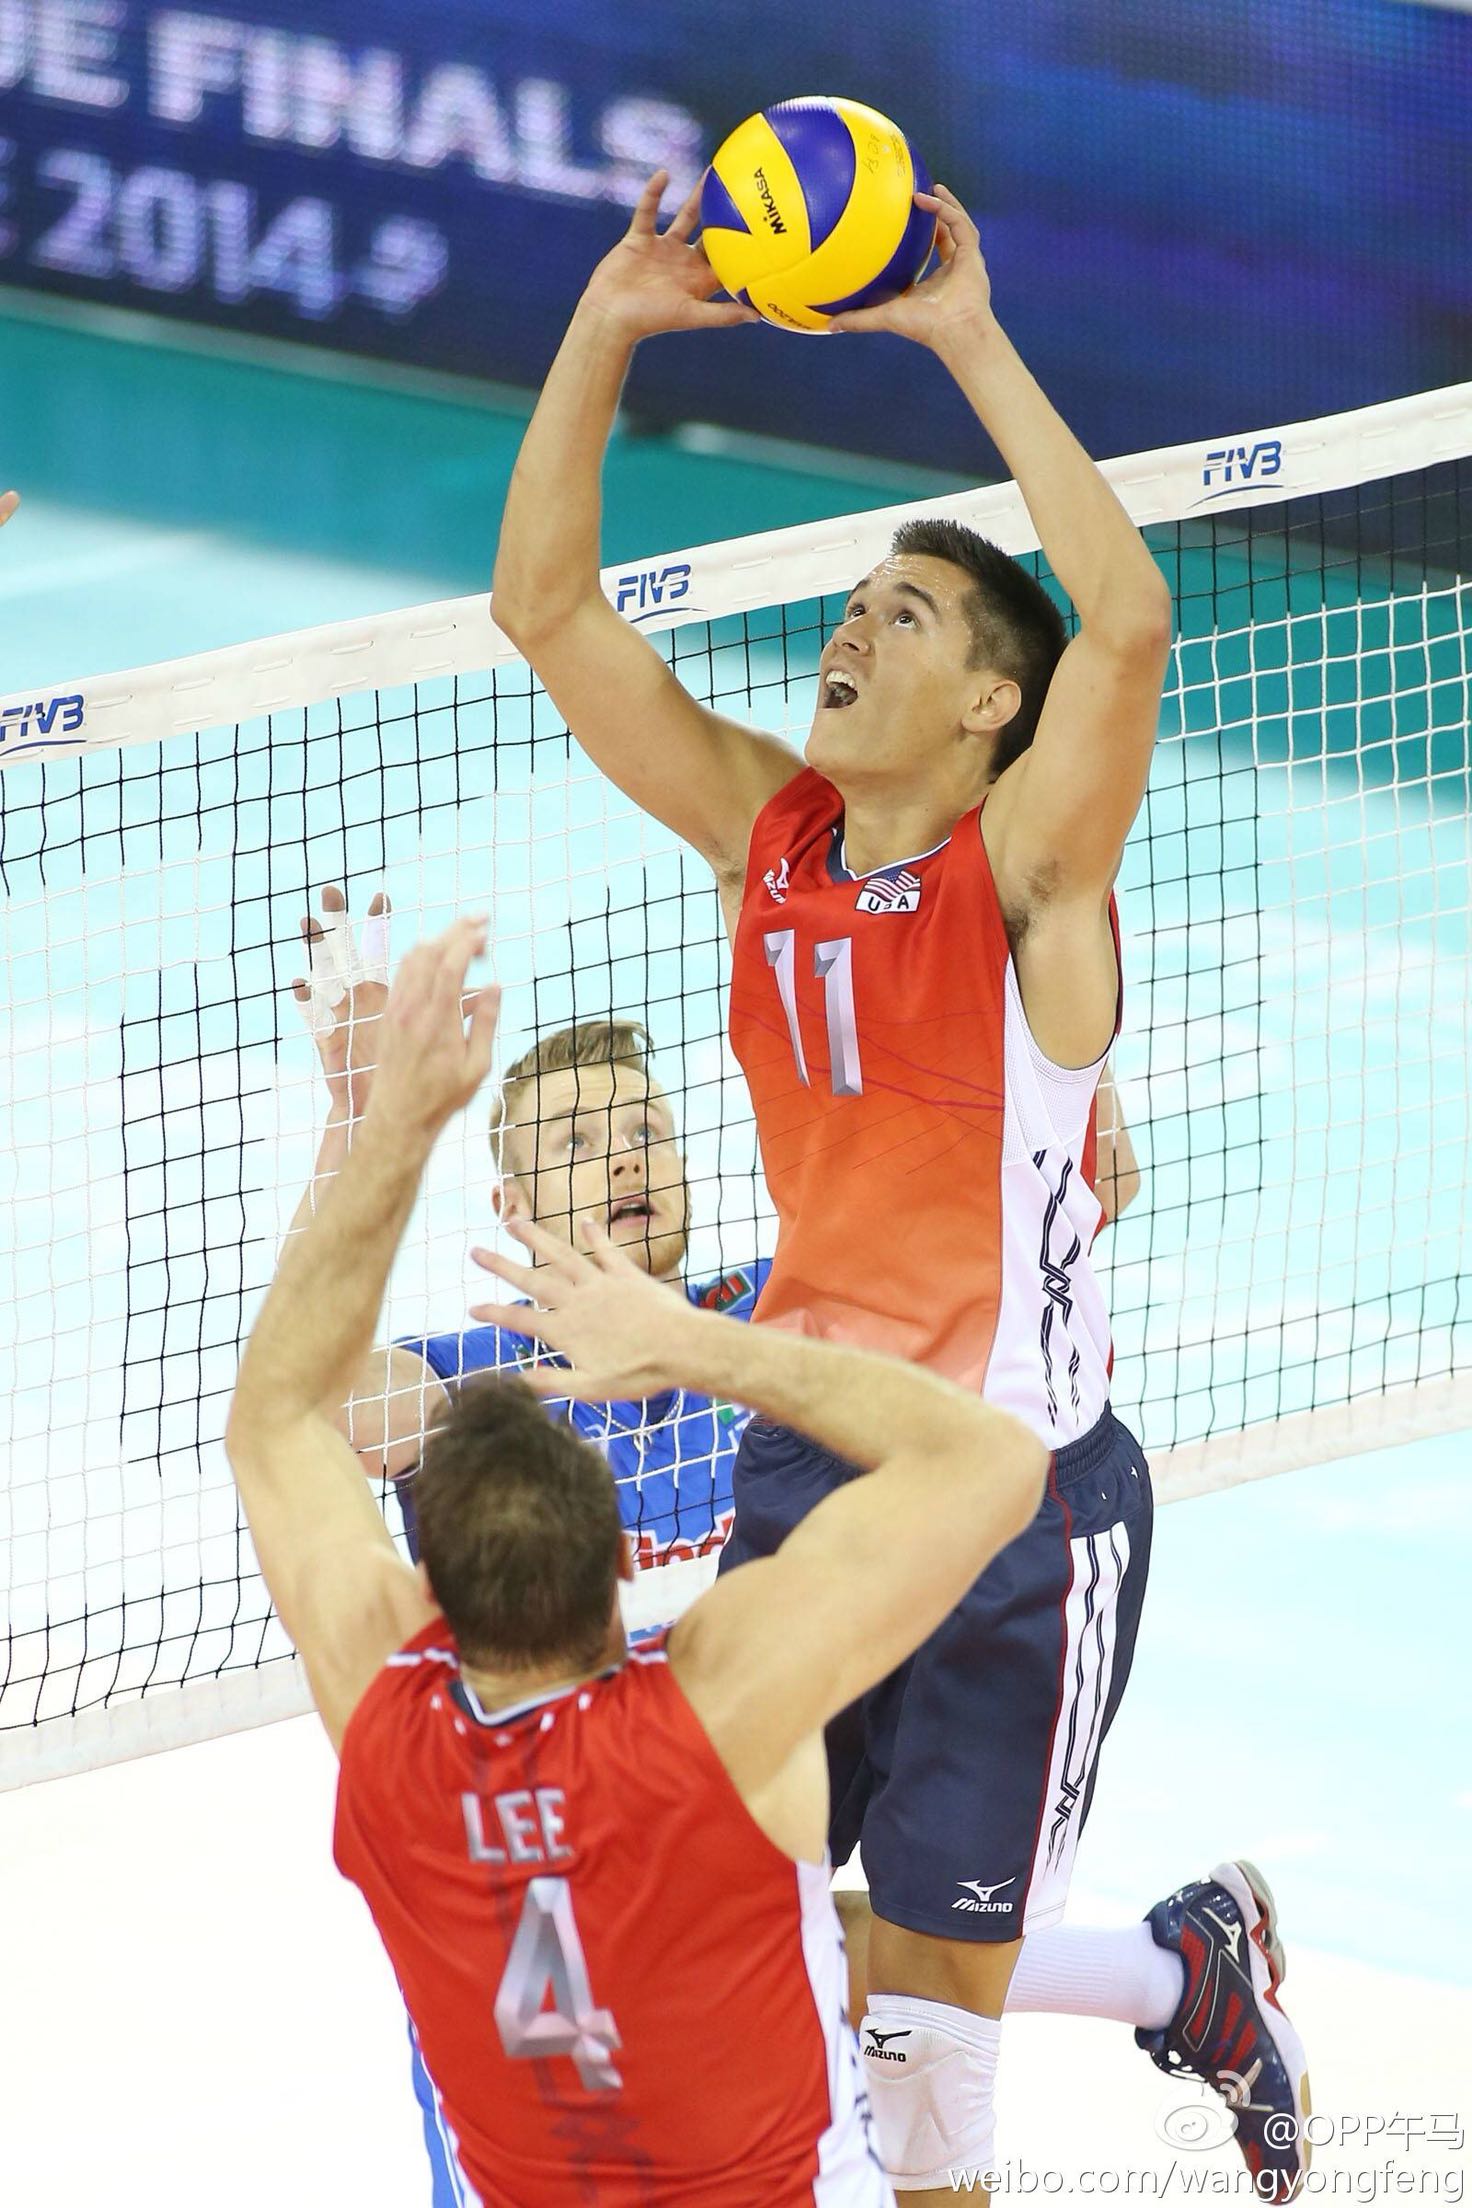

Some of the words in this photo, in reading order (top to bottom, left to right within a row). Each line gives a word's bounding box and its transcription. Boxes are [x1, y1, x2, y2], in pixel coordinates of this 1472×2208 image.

[146, 10, 702, 214] FINALS
[30, 147, 346, 320] 2014
[753, 167, 787, 234] MIKASA
[1203, 440, 1282, 486] FIVB
[617, 564, 691, 612] FIVB
[0, 694, 84, 742] FIVB
[764, 929, 863, 1096] 11
[461, 1787, 573, 1863] LEE
[951, 1897, 1014, 1913] MIZUNO
[494, 1876, 623, 2091] 4
[863, 2045, 907, 2063] MIZUNO
